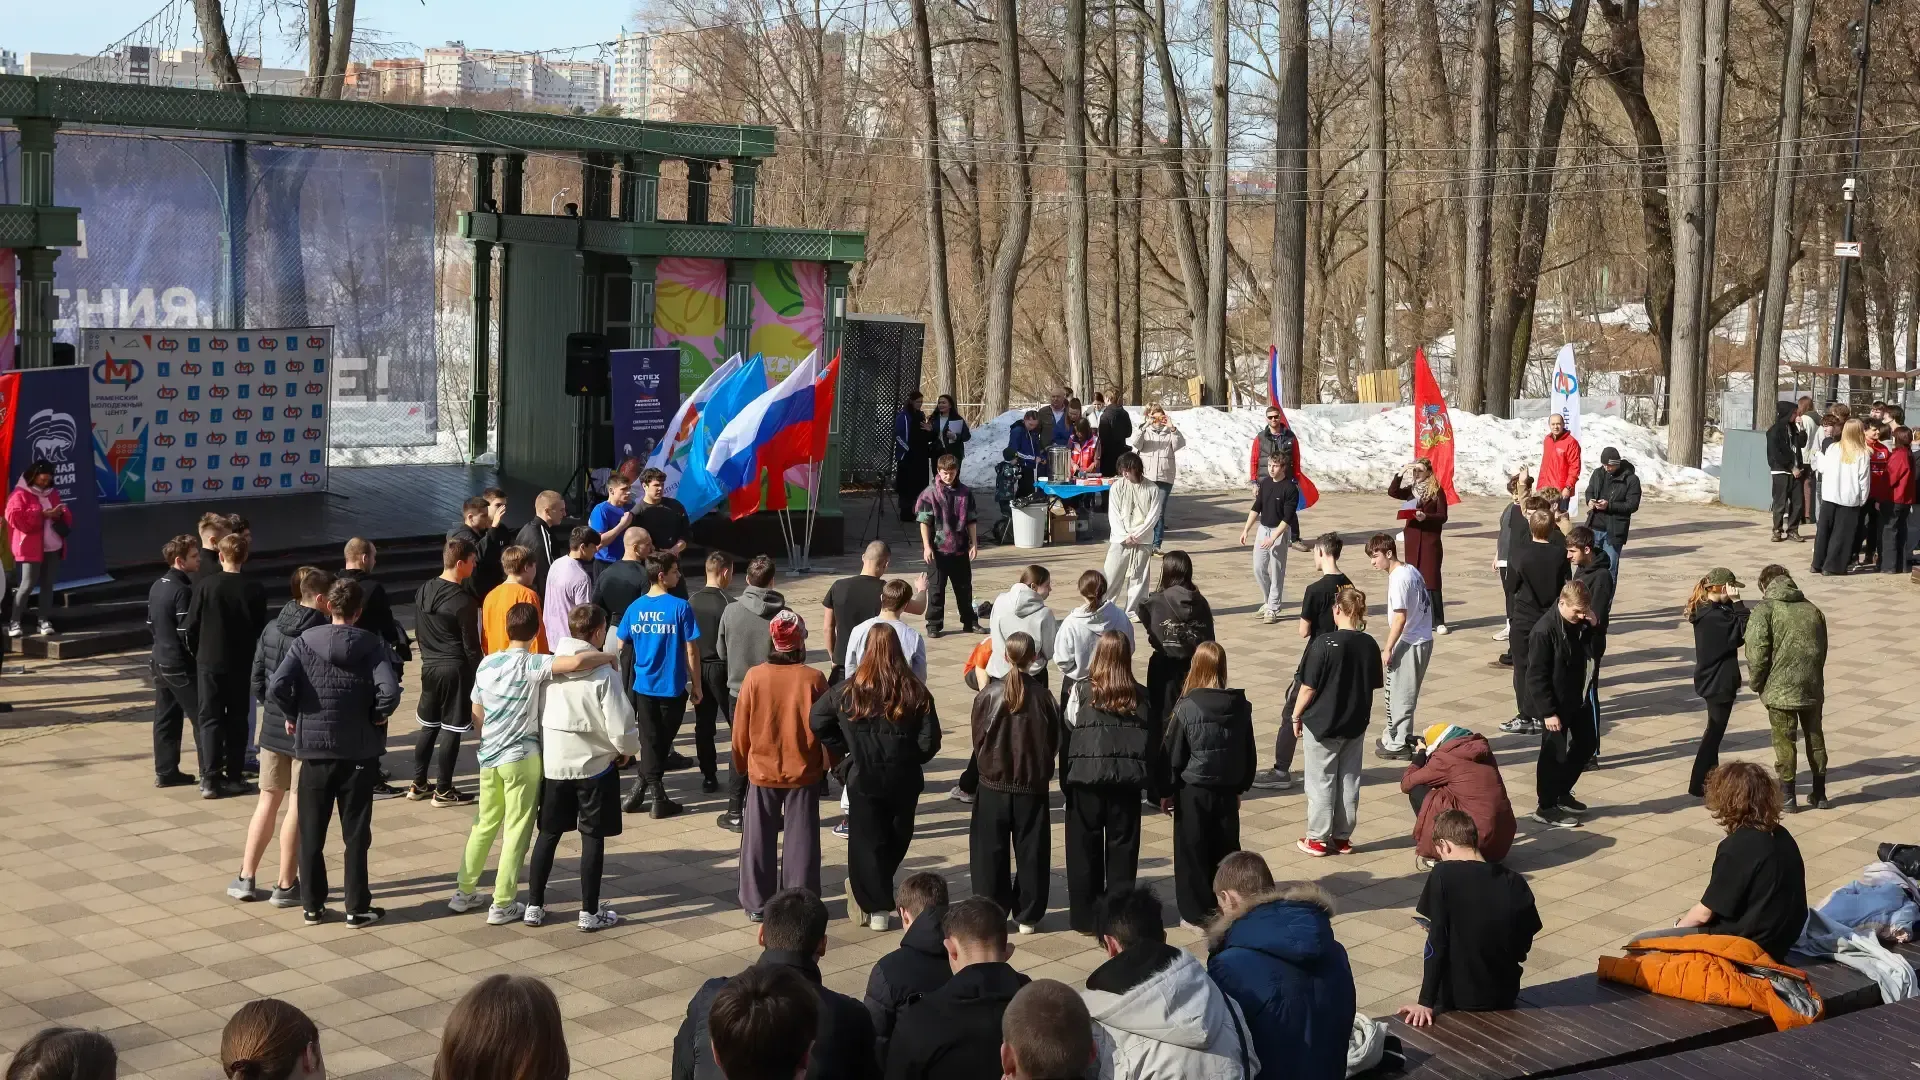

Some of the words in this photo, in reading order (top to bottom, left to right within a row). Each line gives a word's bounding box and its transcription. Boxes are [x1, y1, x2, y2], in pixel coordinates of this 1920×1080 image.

[1562, 406, 1570, 430] НТР
[55, 463, 75, 474] НАЯ
[54, 474, 76, 485] СИЯ
[638, 611, 664, 621] МЧС
